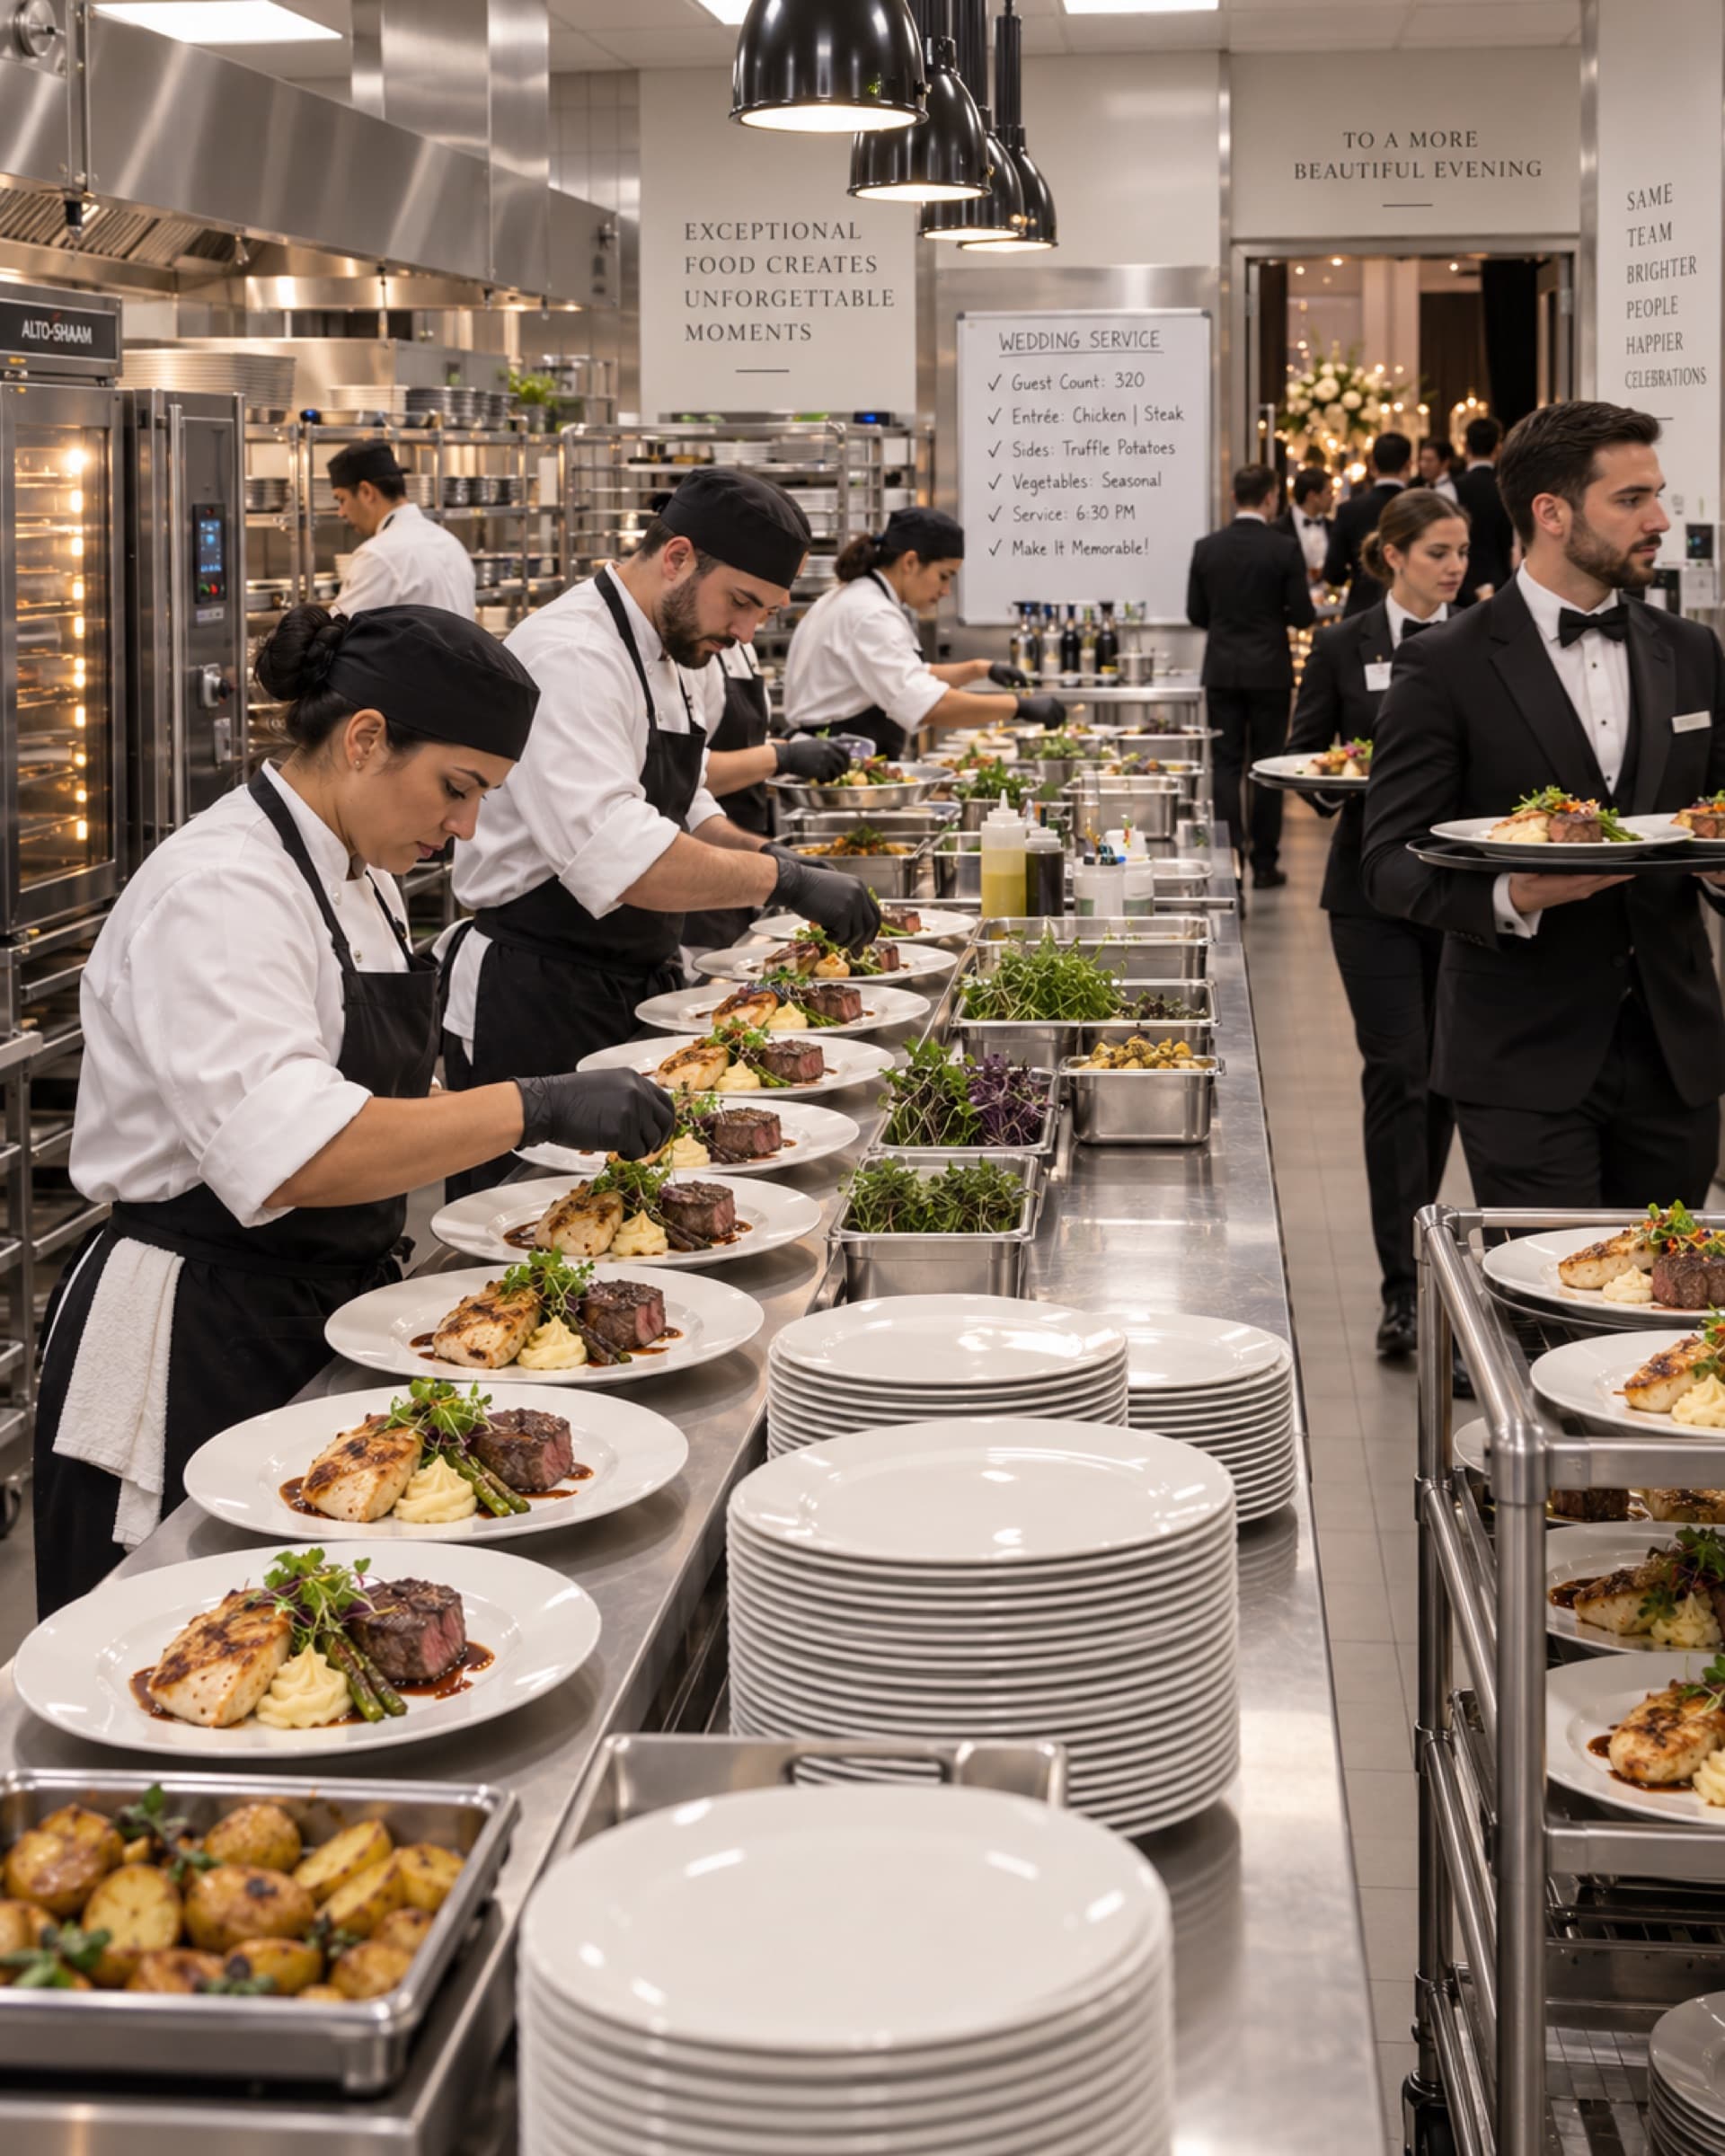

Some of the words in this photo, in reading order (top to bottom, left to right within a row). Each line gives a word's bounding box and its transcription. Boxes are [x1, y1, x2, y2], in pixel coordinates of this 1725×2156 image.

[1343, 131, 1375, 149] TO
[1384, 131, 1399, 148] A
[1410, 130, 1478, 149] MORE
[1294, 161, 1425, 181] BEAUTIFUL
[1434, 160, 1542, 179] EVENING
[1626, 182, 1674, 212] SAME
[685, 222, 862, 241] EXCEPTIONAL
[1626, 220, 1673, 248] TEAM
[685, 255, 756, 275] FOOD
[766, 254, 878, 275] CREATES
[1626, 254, 1697, 285] BRIGHTER
[685, 287, 895, 308] UNFORGETTABLE
[1626, 295, 1679, 320] PEOPLE
[21, 319, 93, 344] ALTO-SHAAM
[685, 323, 812, 342] MOMENTS
[999, 331, 1081, 351] WEDDING
[1090, 330, 1161, 349] SERVICE
[1625, 331, 1684, 356] HAPPIER
[1011, 373, 1053, 392] Guest
[1059, 373, 1106, 391] Count:
[1114, 371, 1146, 389] 320
[1624, 366, 1708, 390] CELEBRATIONS
[1012, 406, 1065, 425] Entrée:
[1072, 404, 1127, 424] Chicken
[1144, 404, 1184, 423] Steak
[1013, 440, 1057, 458] Sides:
[1062, 438, 1110, 456] Truffle
[1117, 437, 1176, 456] Potatoes
[1012, 472, 1093, 497] Vegetables:
[1101, 471, 1163, 489] Seasonal
[1013, 505, 1069, 523] Service:
[1075, 503, 1110, 521] 6:30
[1115, 503, 1136, 521] PM
[1012, 539, 1048, 556] Make
[1054, 539, 1066, 556] It
[1072, 537, 1149, 557] Memorable!
